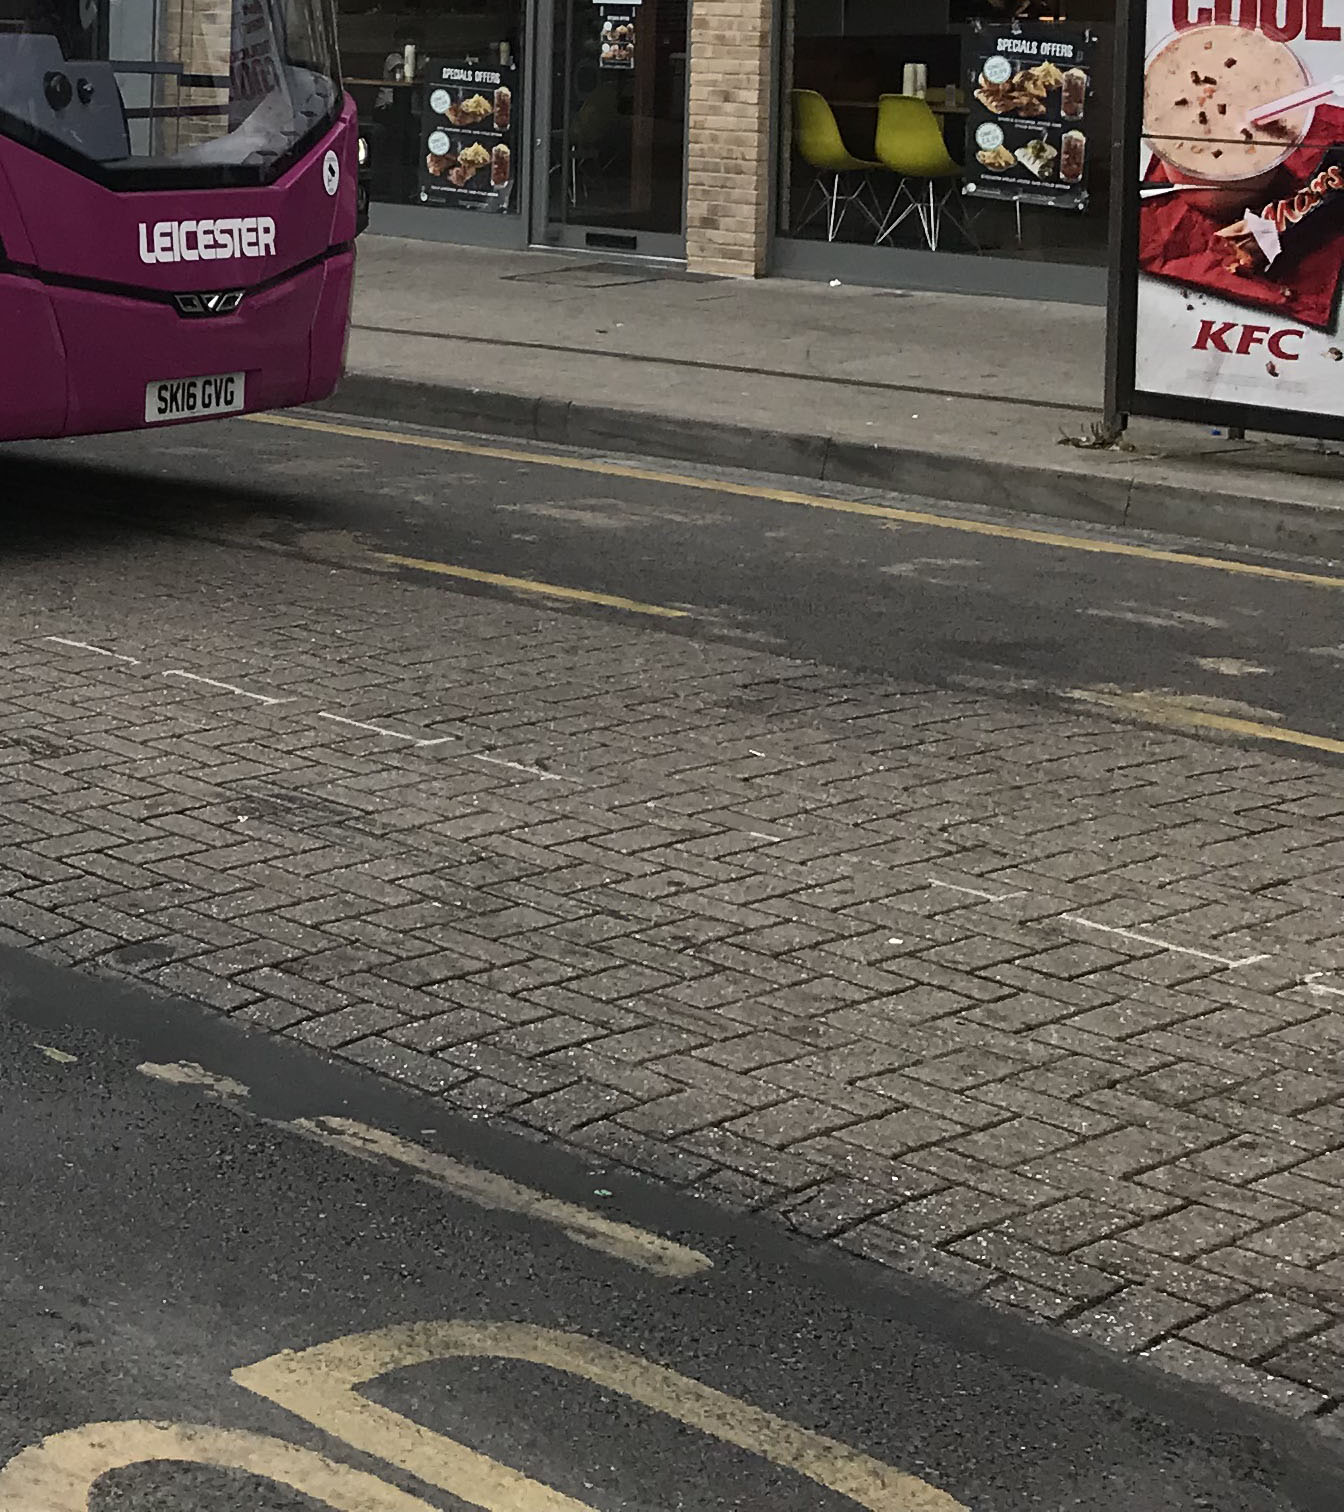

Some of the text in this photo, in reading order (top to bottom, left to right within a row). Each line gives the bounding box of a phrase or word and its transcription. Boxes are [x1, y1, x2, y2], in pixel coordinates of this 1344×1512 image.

[997, 38, 1074, 58] SPECIALS OFFERS
[442, 67, 501, 85] SPECIALS OFFERS
[1263, 165, 1344, 233] Mars
[138, 216, 276, 264] LEICESTER
[1192, 319, 1305, 361] KFC
[157, 378, 235, 414] SK16 GVG
